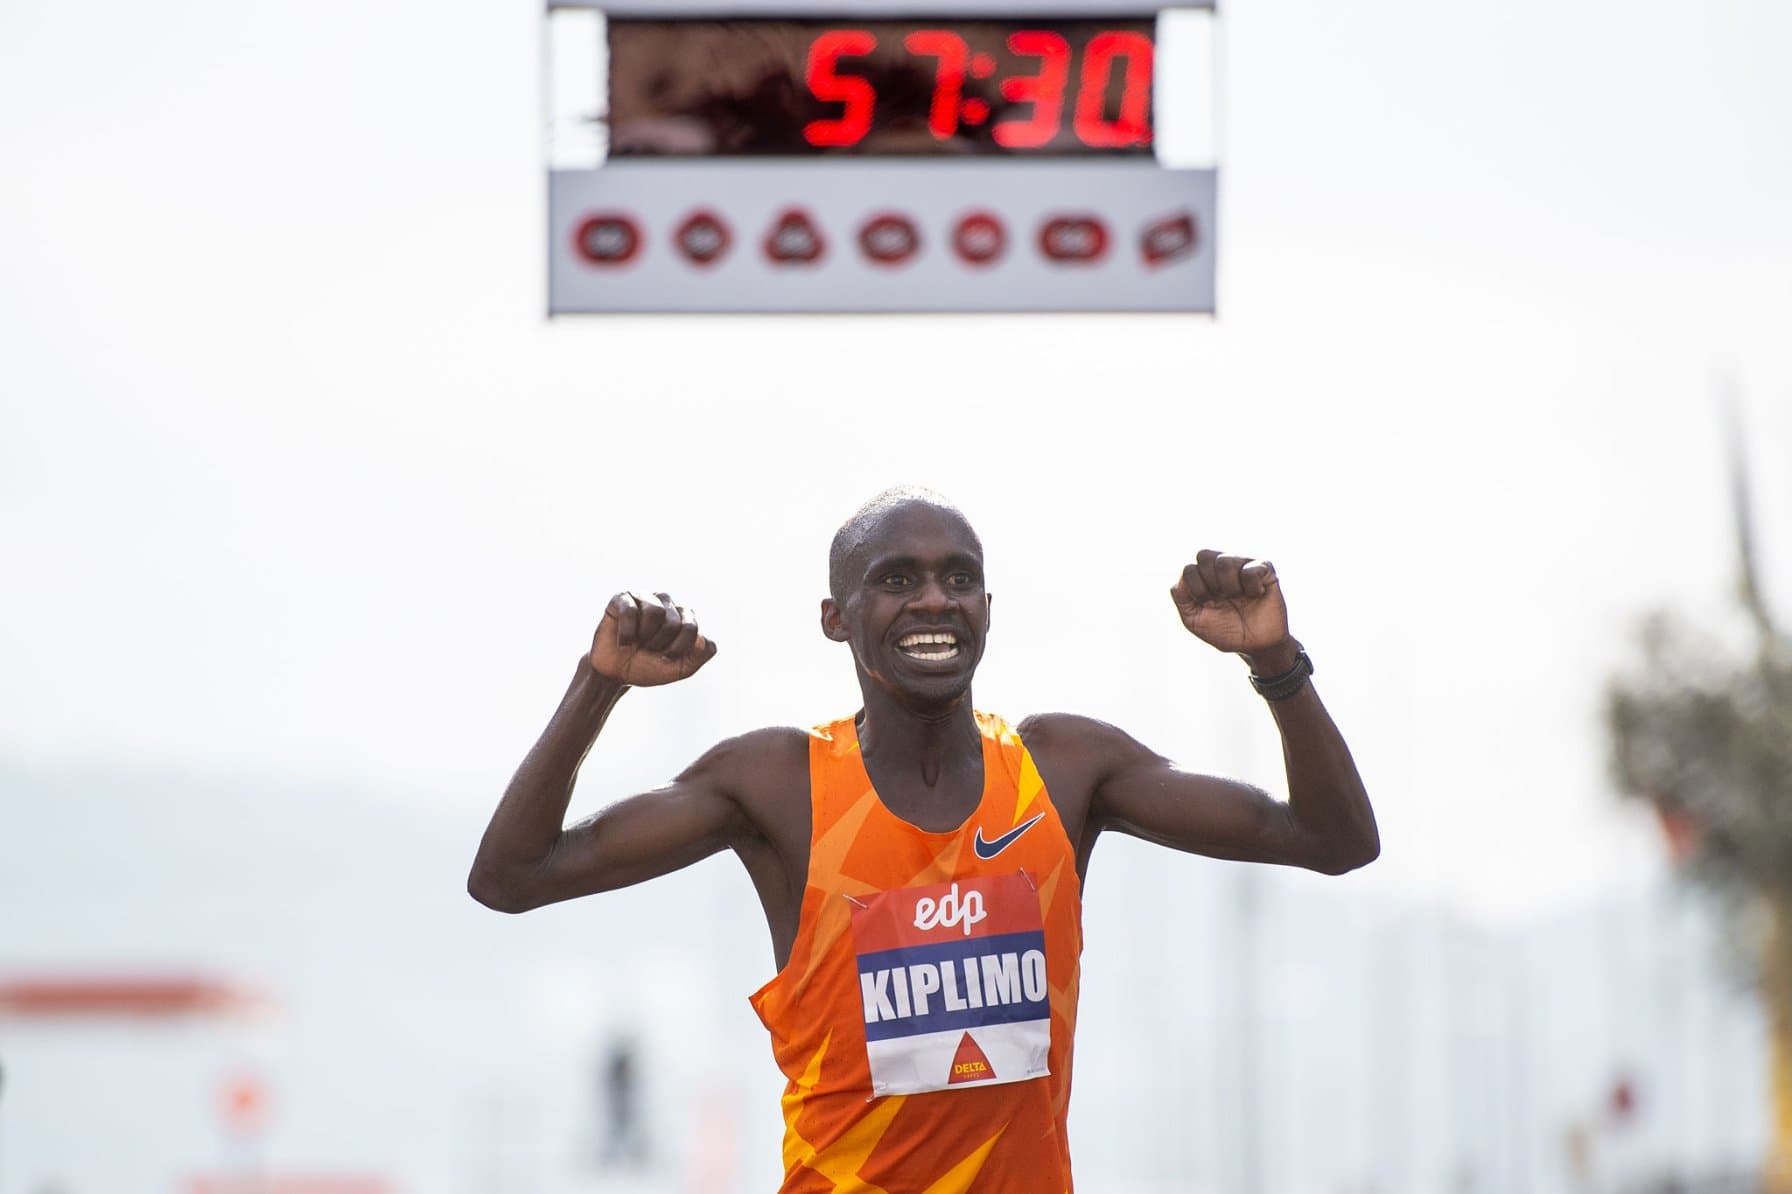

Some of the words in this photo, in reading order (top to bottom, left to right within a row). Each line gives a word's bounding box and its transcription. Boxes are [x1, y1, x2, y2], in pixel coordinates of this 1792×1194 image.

[804, 30, 1153, 147] 57:30
[914, 883, 987, 935] edp
[860, 949, 1047, 1023] KIPLIMO
[954, 1061, 987, 1074] DELTA
